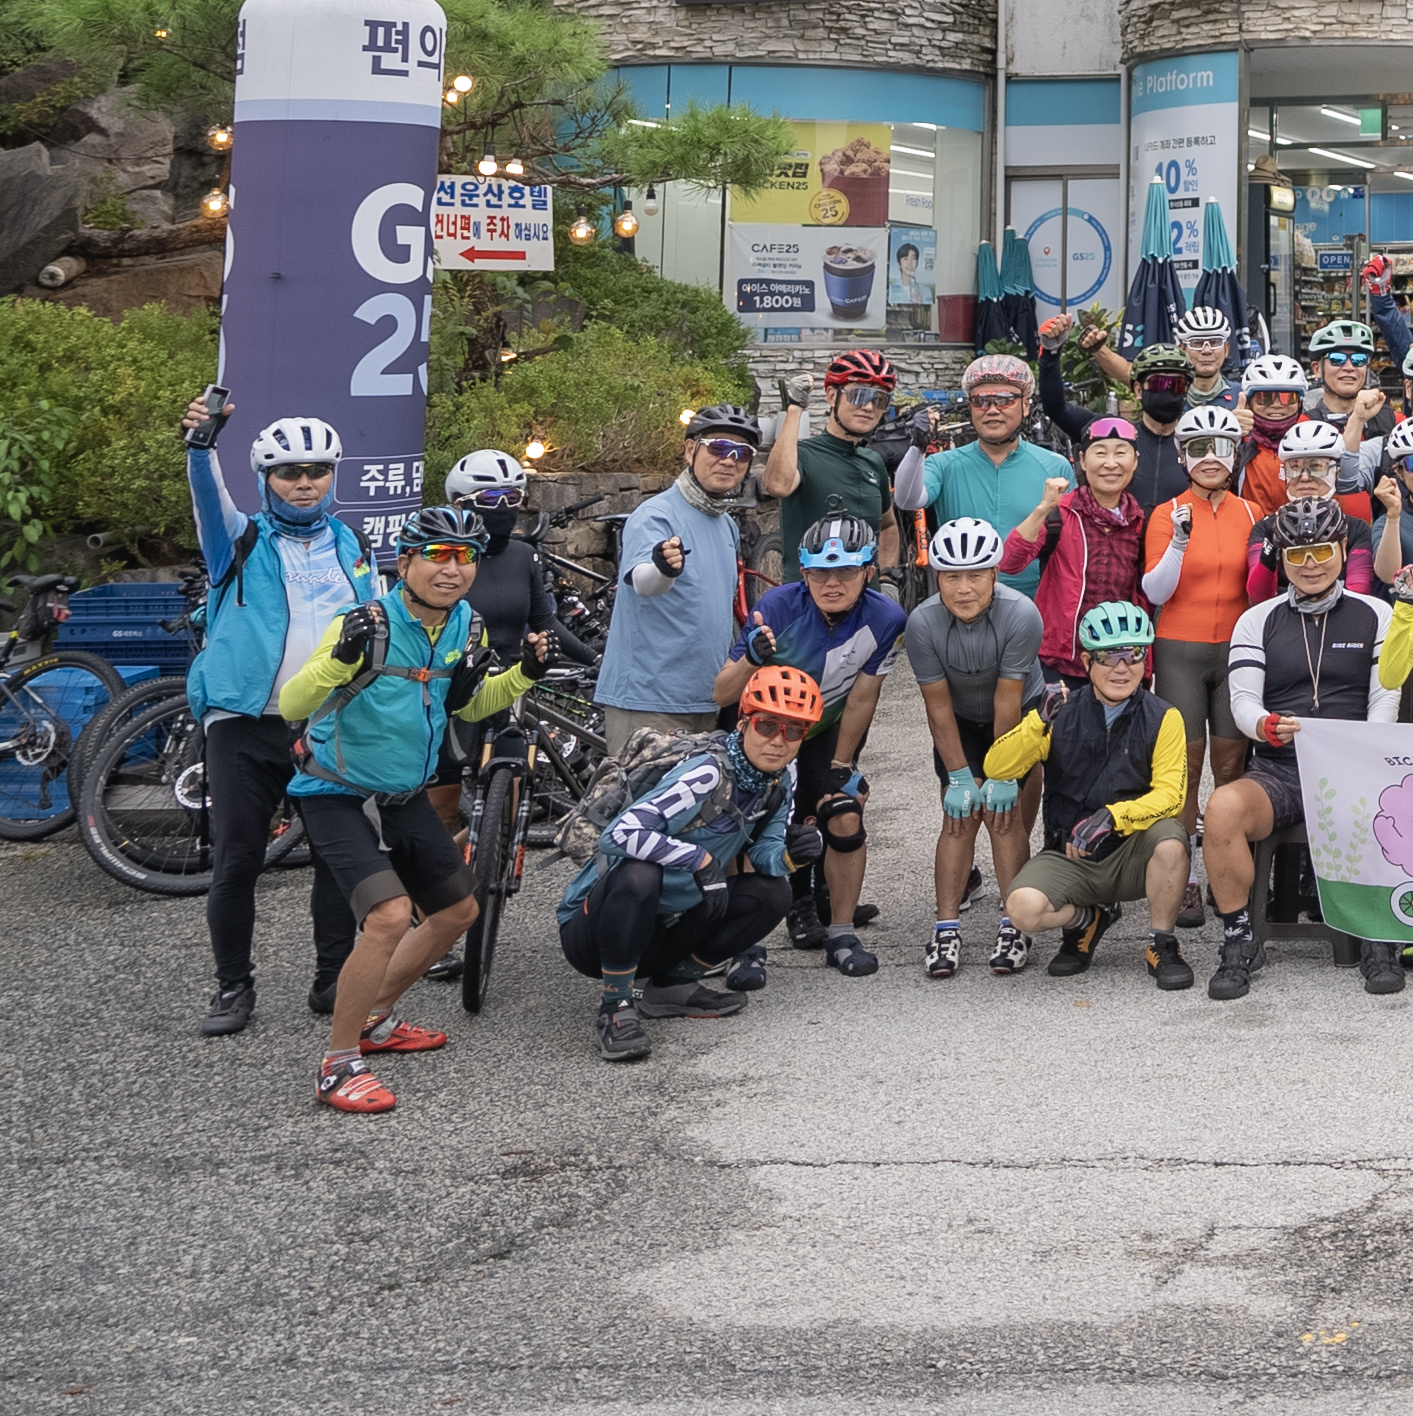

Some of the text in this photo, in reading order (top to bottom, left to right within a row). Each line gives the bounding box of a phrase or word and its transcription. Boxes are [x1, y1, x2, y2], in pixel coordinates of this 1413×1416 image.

[1146, 69, 1214, 95] Platform
[436, 180, 549, 211] 선운산호텔
[351, 182, 433, 285] G
[486, 215, 511, 241] 주차
[1322, 255, 1351, 264] OPEN
